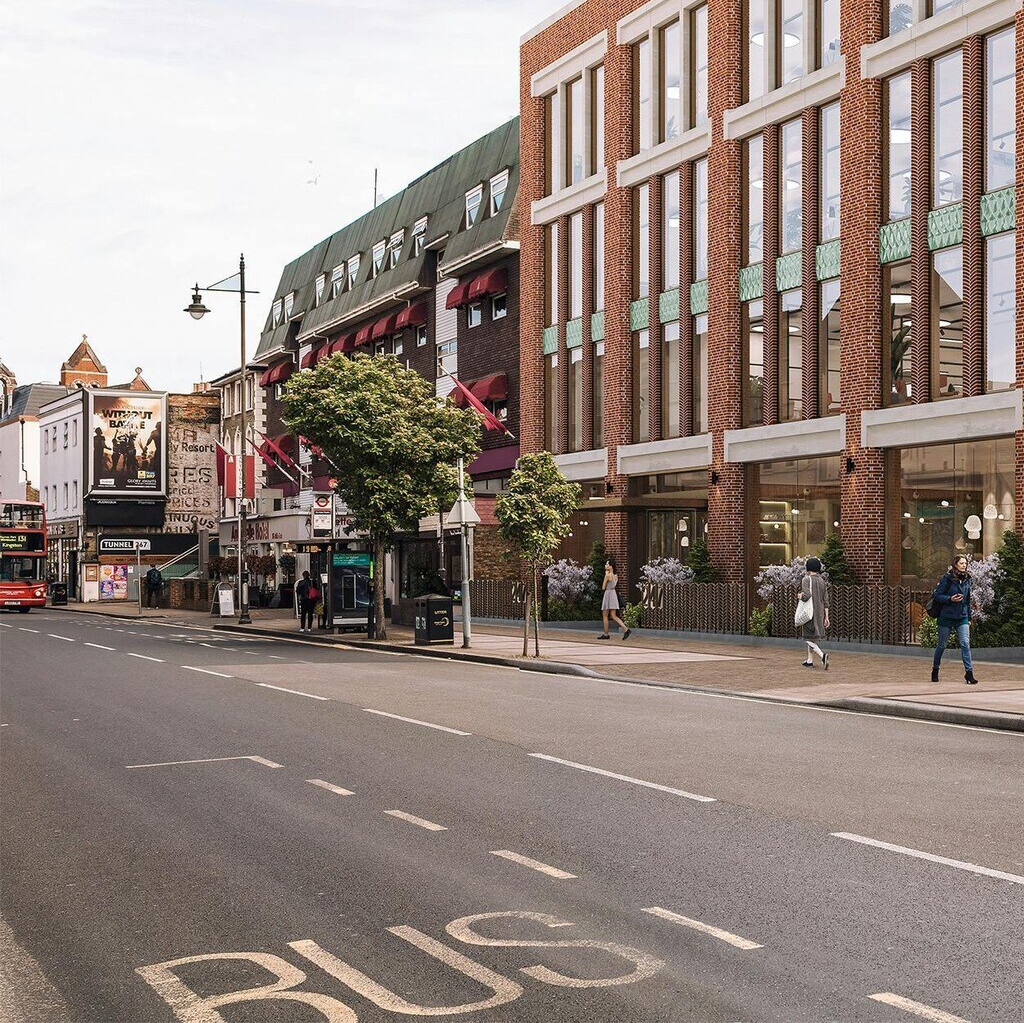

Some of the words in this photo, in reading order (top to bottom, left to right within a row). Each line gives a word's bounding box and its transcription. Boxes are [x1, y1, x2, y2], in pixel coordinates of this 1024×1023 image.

[102, 409, 153, 419] WITHOUT
[182, 442, 215, 453] Resort
[135, 911, 667, 1023] BUS
